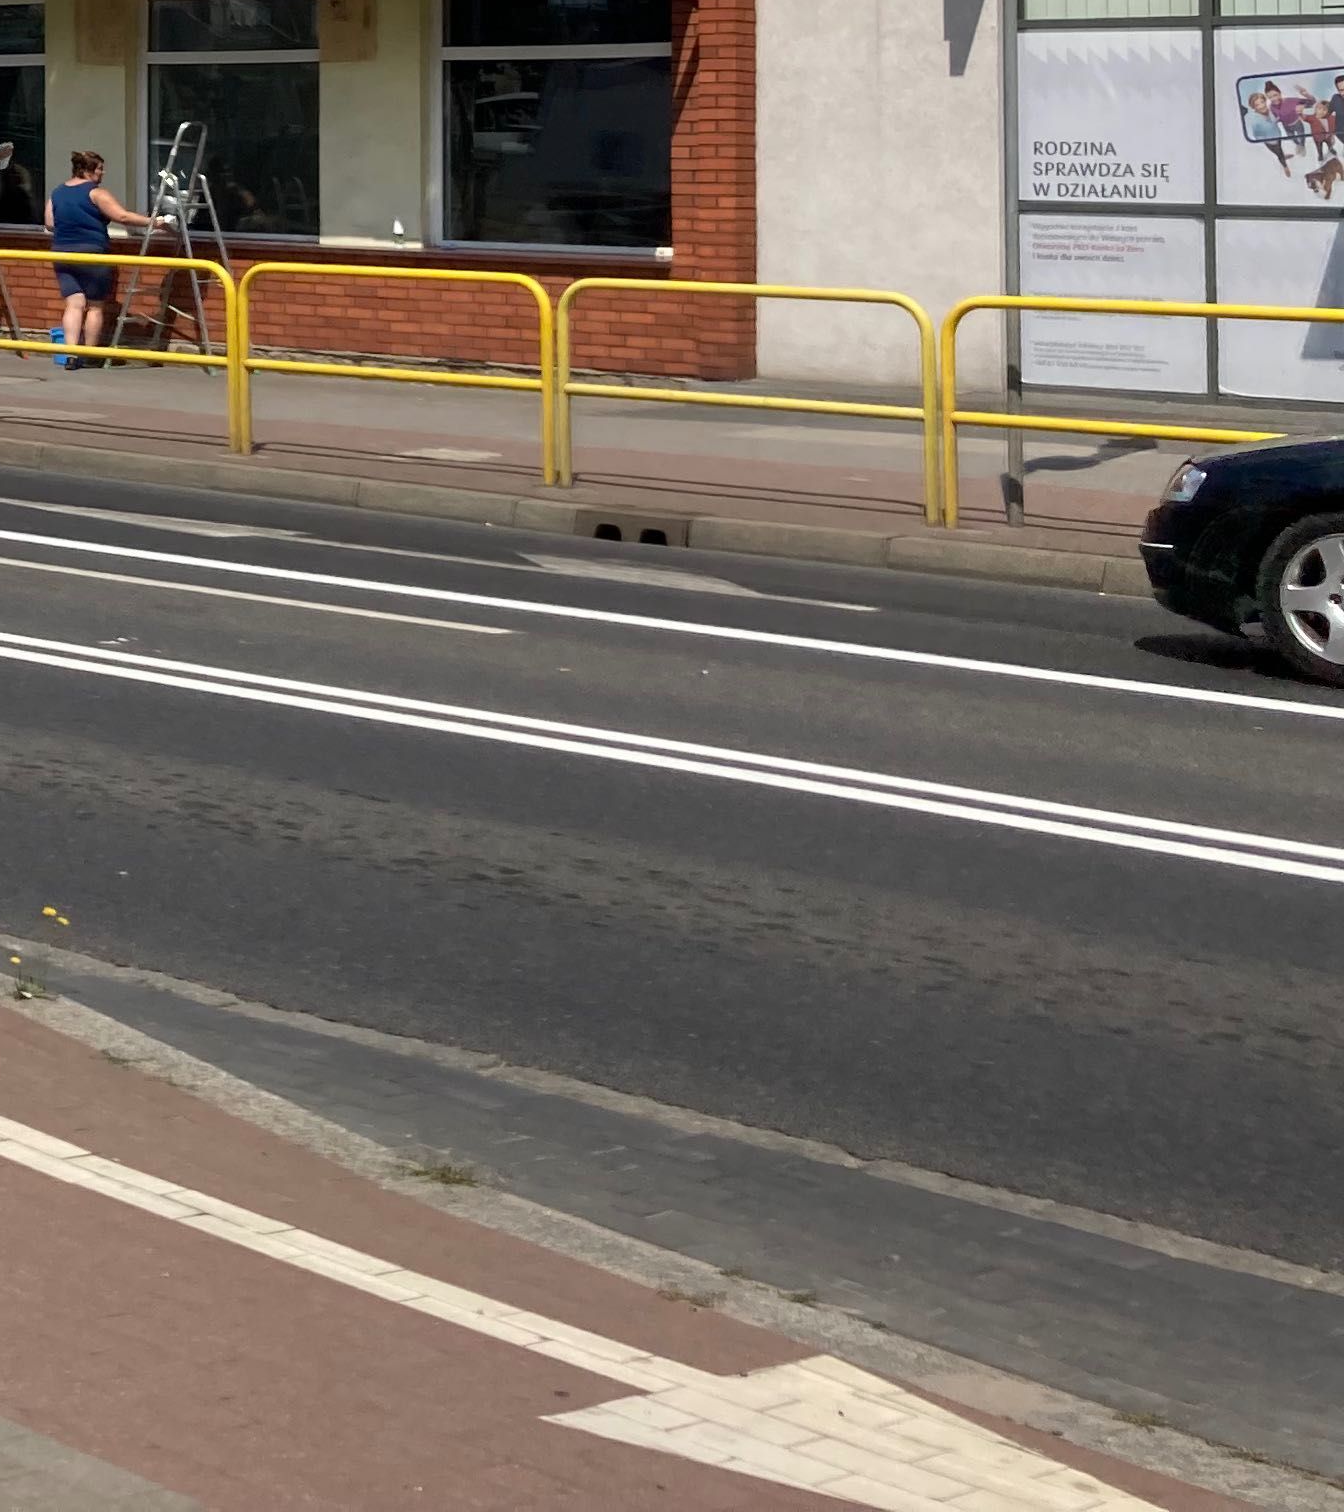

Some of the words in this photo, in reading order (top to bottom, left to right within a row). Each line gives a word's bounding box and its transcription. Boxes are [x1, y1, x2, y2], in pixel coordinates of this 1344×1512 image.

[1033, 141, 1117, 156] RODZINA
[1032, 162, 1135, 178] SPRAWDZA
[1140, 163, 1170, 183] SIĘ
[1032, 182, 1051, 197] W
[1057, 183, 1158, 199] DZIAŁANIU
